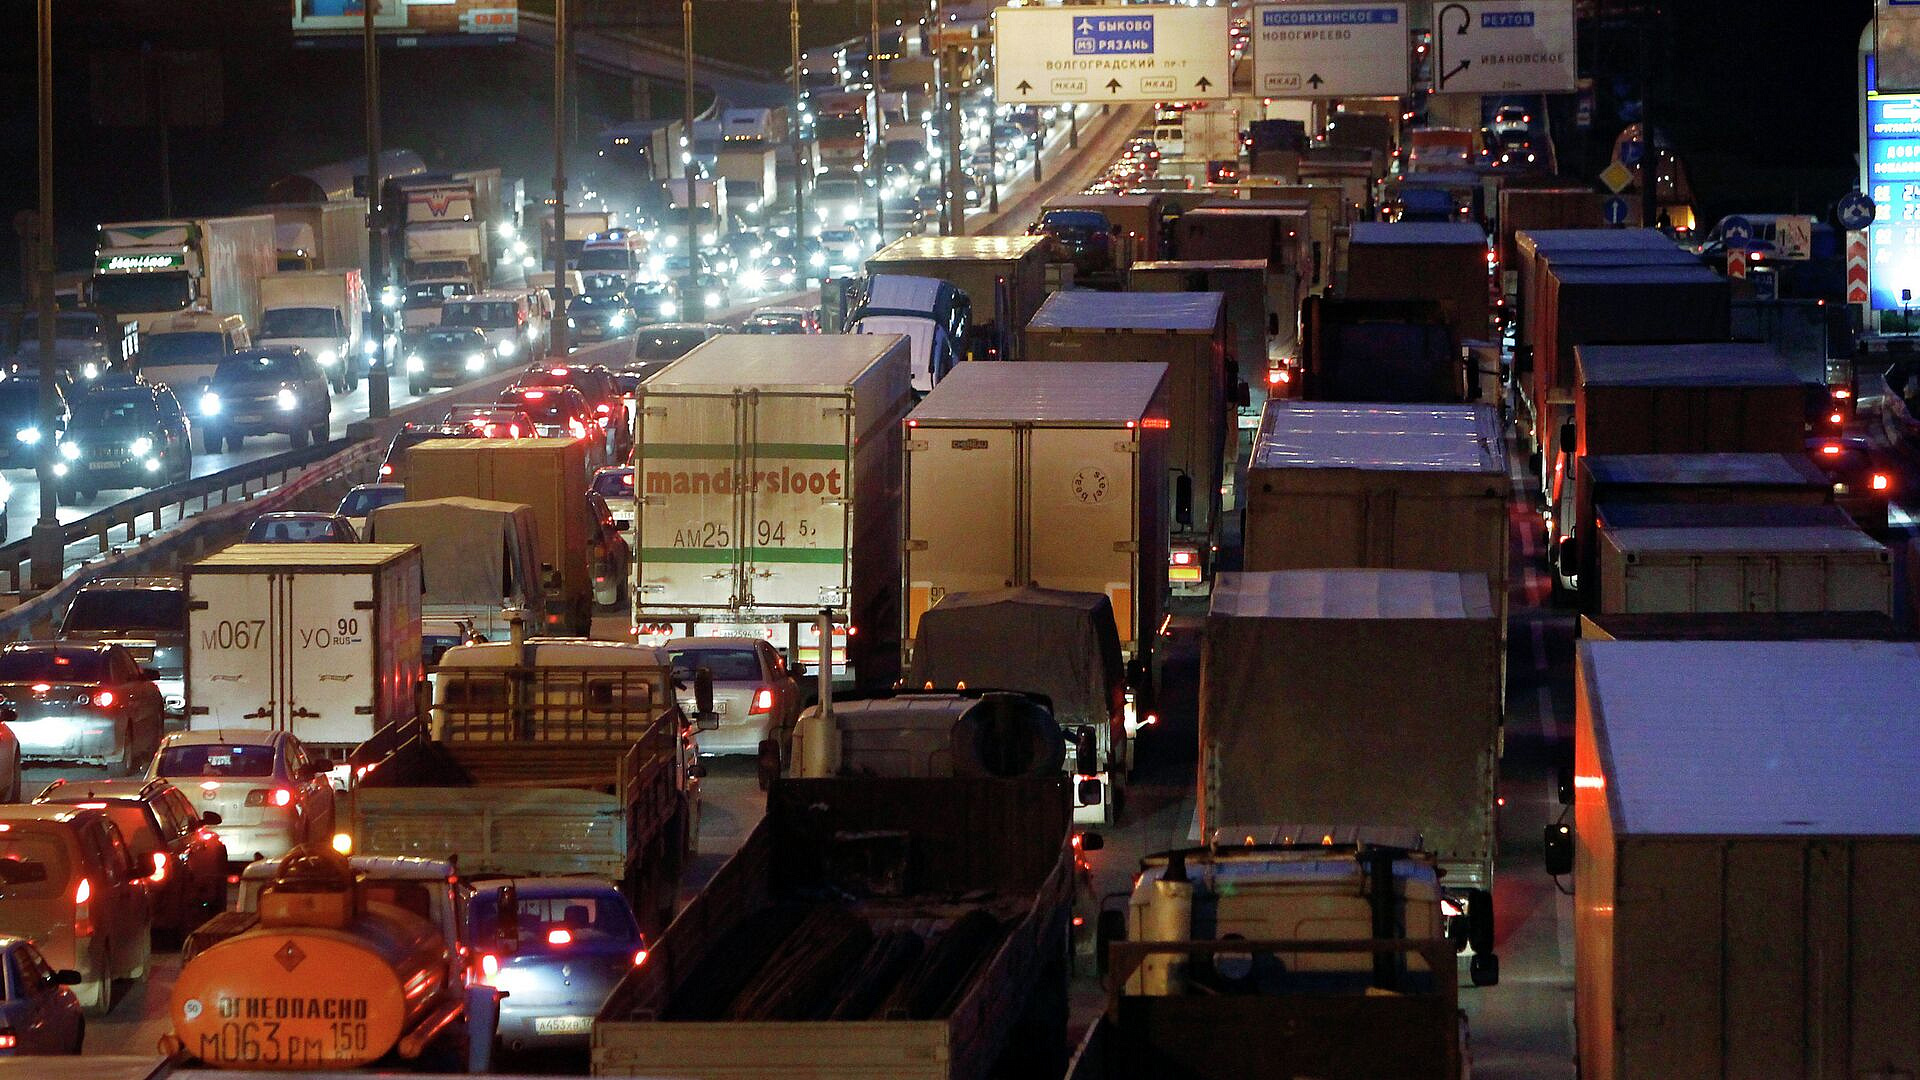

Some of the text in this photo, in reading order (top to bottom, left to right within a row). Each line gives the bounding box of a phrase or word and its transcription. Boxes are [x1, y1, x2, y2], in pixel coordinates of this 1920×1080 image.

[1098, 20, 1151, 32] БЫКОВО
[1262, 30, 1352, 41] НОВОГИРЕЕВО
[1098, 39, 1149, 51] РЯЗАНЬ
[1046, 58, 1155, 70] ВОЛГОГРАДСКИЙ
[1055, 81, 1084, 91] МКАД
[1144, 79, 1174, 88] МКАД
[757, 520, 786, 547] 94
[337, 618, 358, 636] 90
[332, 636, 351, 646] RUS
[219, 997, 367, 1020] ОГНЕОПАСНО
[330, 1022, 367, 1050] 150
